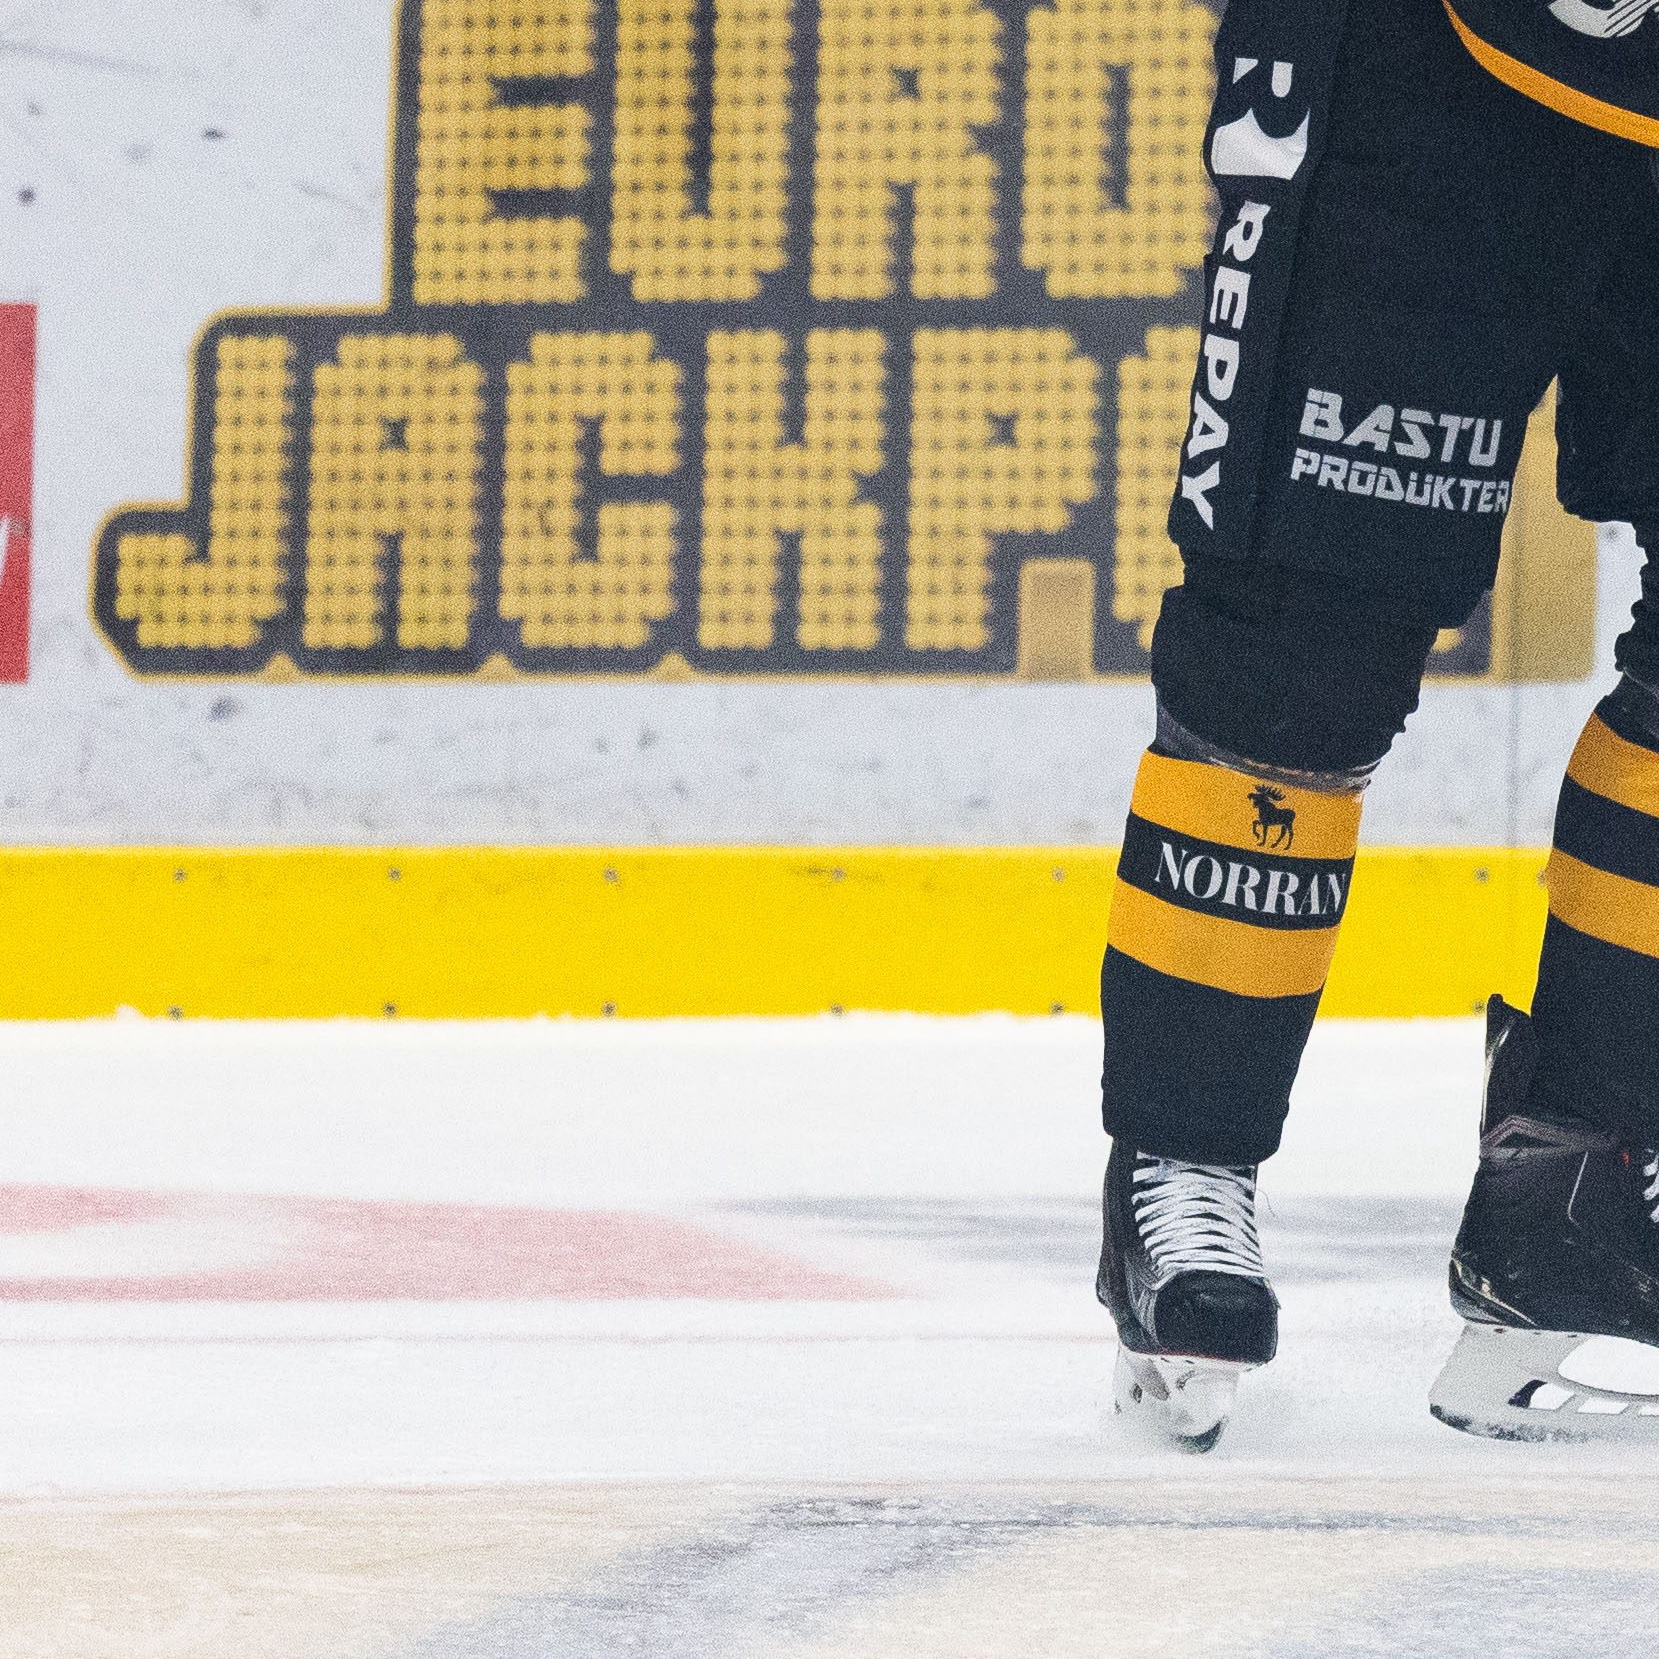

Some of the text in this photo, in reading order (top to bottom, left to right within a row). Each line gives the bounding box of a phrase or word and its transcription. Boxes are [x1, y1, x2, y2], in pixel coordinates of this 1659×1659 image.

[1181, 199, 1271, 531] REPAY
[1299, 388, 1503, 467] BASTU
[1154, 841, 1347, 916] NORRAN
